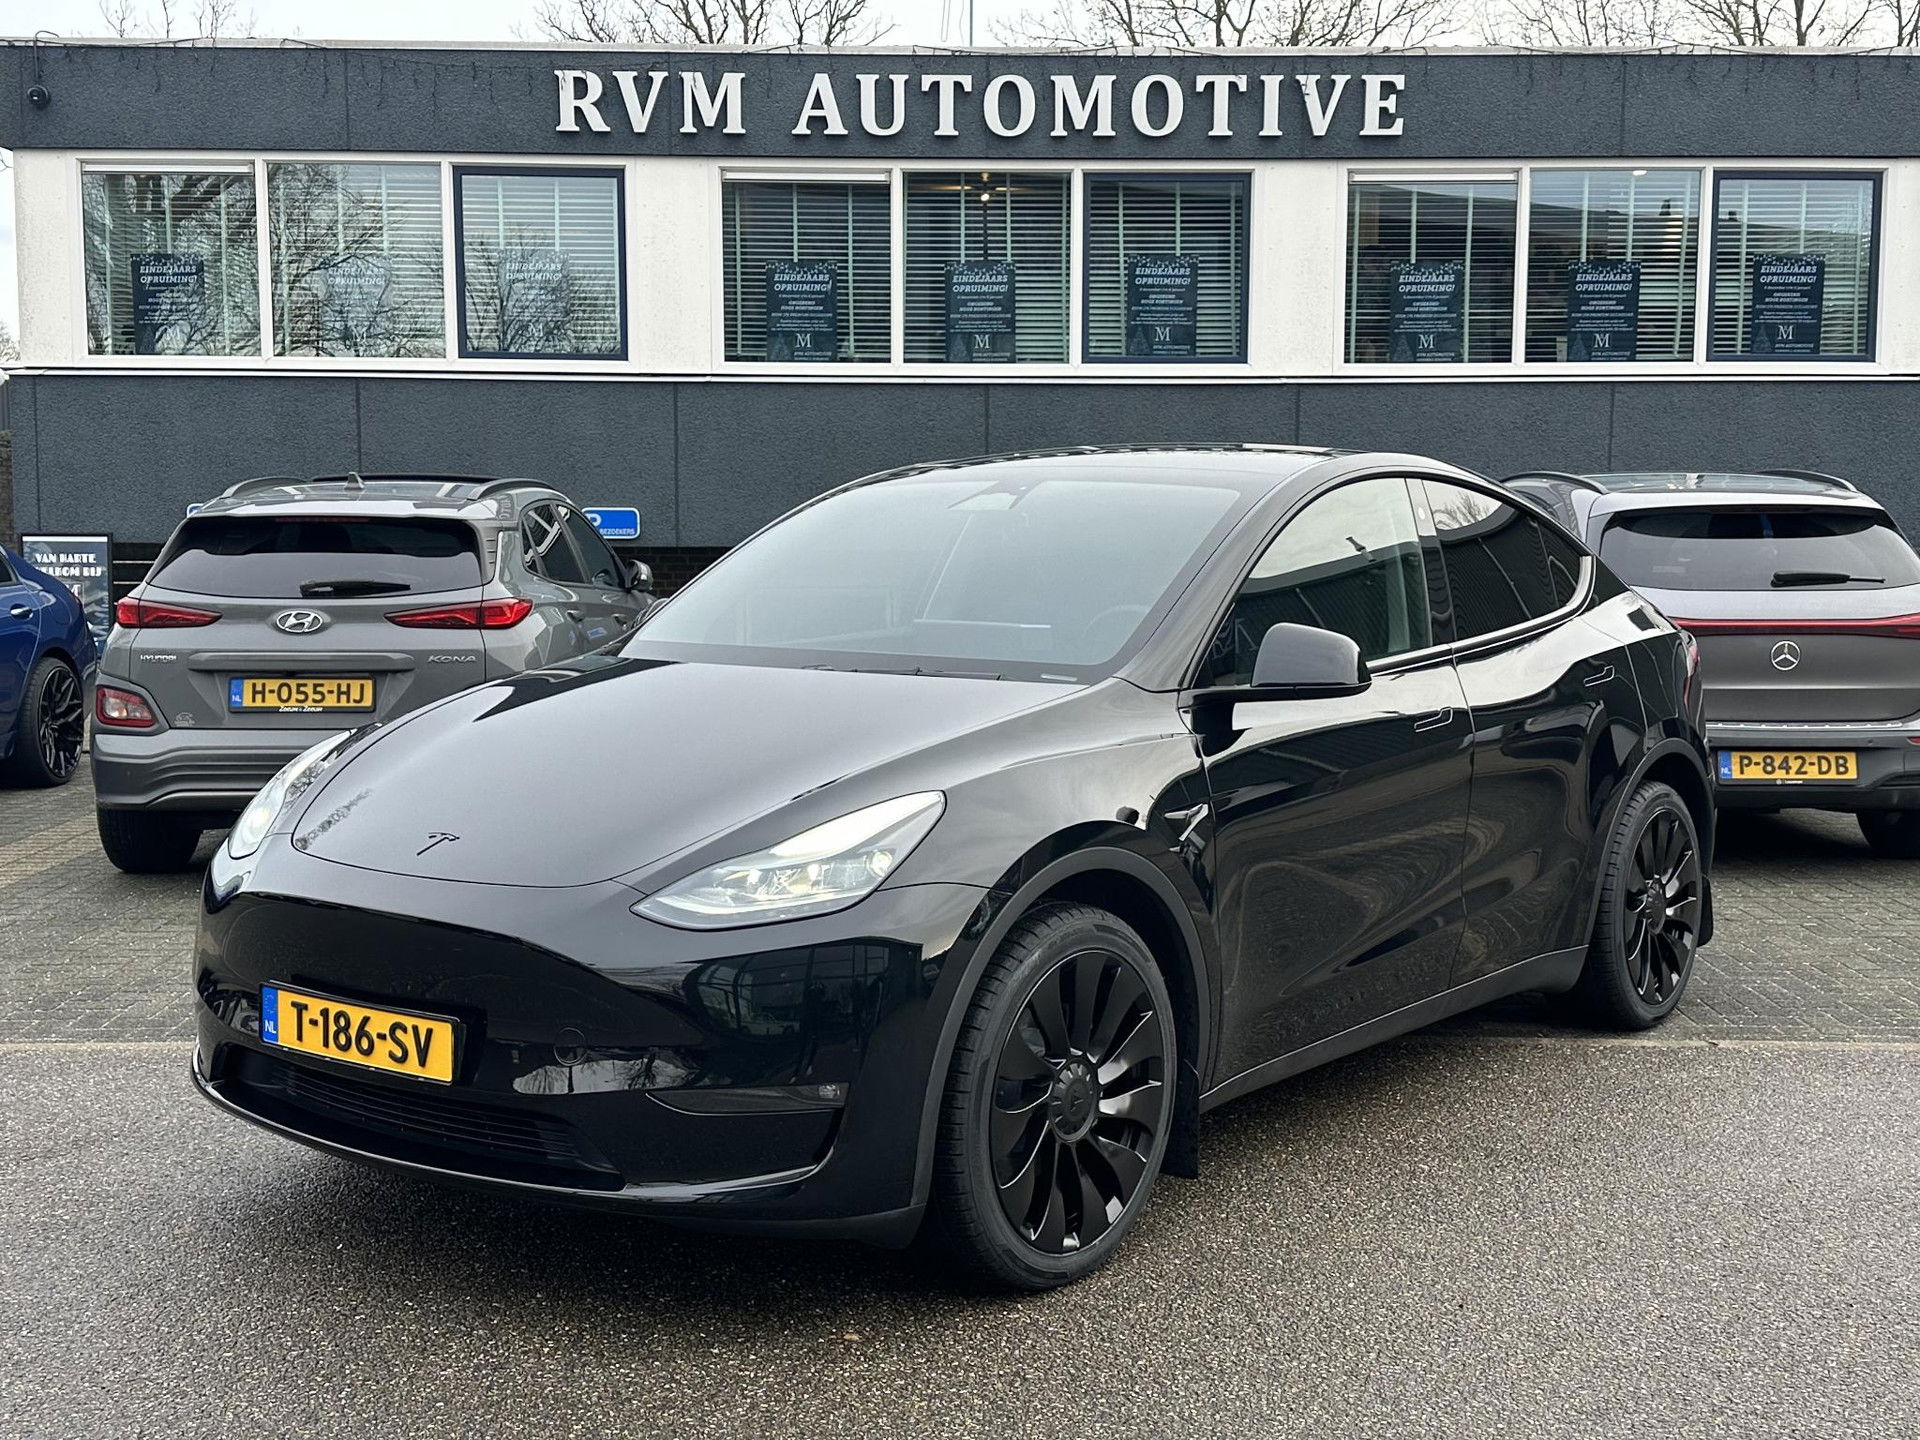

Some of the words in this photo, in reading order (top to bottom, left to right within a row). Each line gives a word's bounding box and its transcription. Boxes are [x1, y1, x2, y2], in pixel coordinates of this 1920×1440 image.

[554, 69, 747, 135] RVM
[791, 72, 1406, 138] AUTOMOTIVE
[1135, 267, 1191, 275] EINDEJAARS
[1760, 265, 1817, 273] EINDEJAARS
[773, 273, 830, 281] EINDEJAARS
[952, 275, 1009, 283] EINDEJAARS
[1135, 277, 1191, 285] OPRUIMING!
[1398, 274, 1455, 283] EINDEJAARS
[1575, 273, 1633, 282] EINDEJAARS
[1760, 275, 1817, 283] OPRUIMING!
[952, 284, 1008, 292] OPRUIMING!
[1398, 284, 1455, 292] OPRUIMING!
[1575, 283, 1633, 291] OPRUIMING!
[35, 553, 56, 563] VAN
[251, 682, 365, 704] H-055-HJ
[1739, 755, 1849, 775] P-842-DB
[264, 1020, 277, 1034] NL
[291, 1000, 434, 1068] T-186-SV
